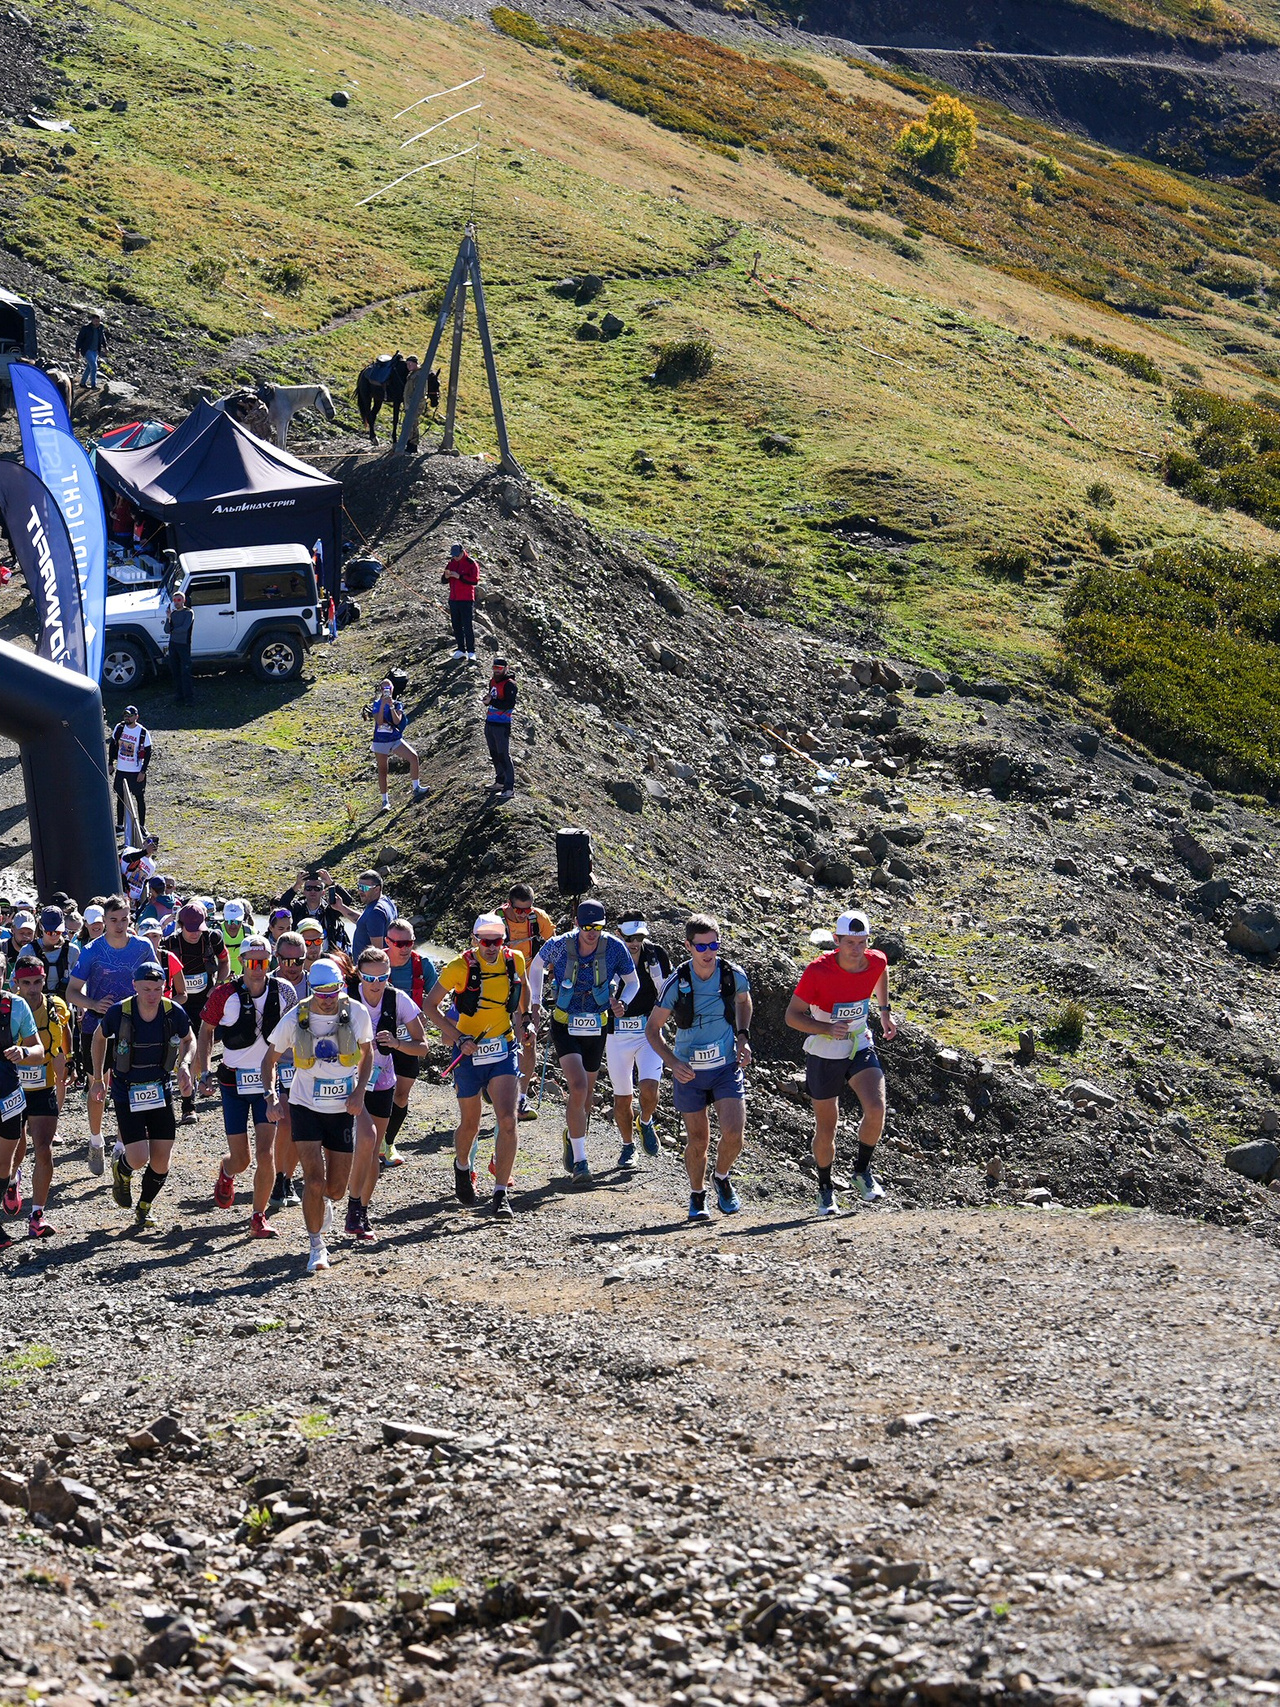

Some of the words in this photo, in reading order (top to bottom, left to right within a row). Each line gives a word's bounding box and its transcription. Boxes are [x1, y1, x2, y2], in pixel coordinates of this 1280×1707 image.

[839, 1006, 863, 1017] 1050
[574, 1018, 597, 1027] 1070
[621, 1020, 640, 1029] 1129
[479, 1042, 501, 1055] 1067
[699, 1049, 716, 1060] 1117
[21, 1071, 38, 1079] 1115
[135, 1089, 158, 1101] 1025
[323, 1085, 345, 1095] 1103
[4, 1094, 22, 1110] 1073
